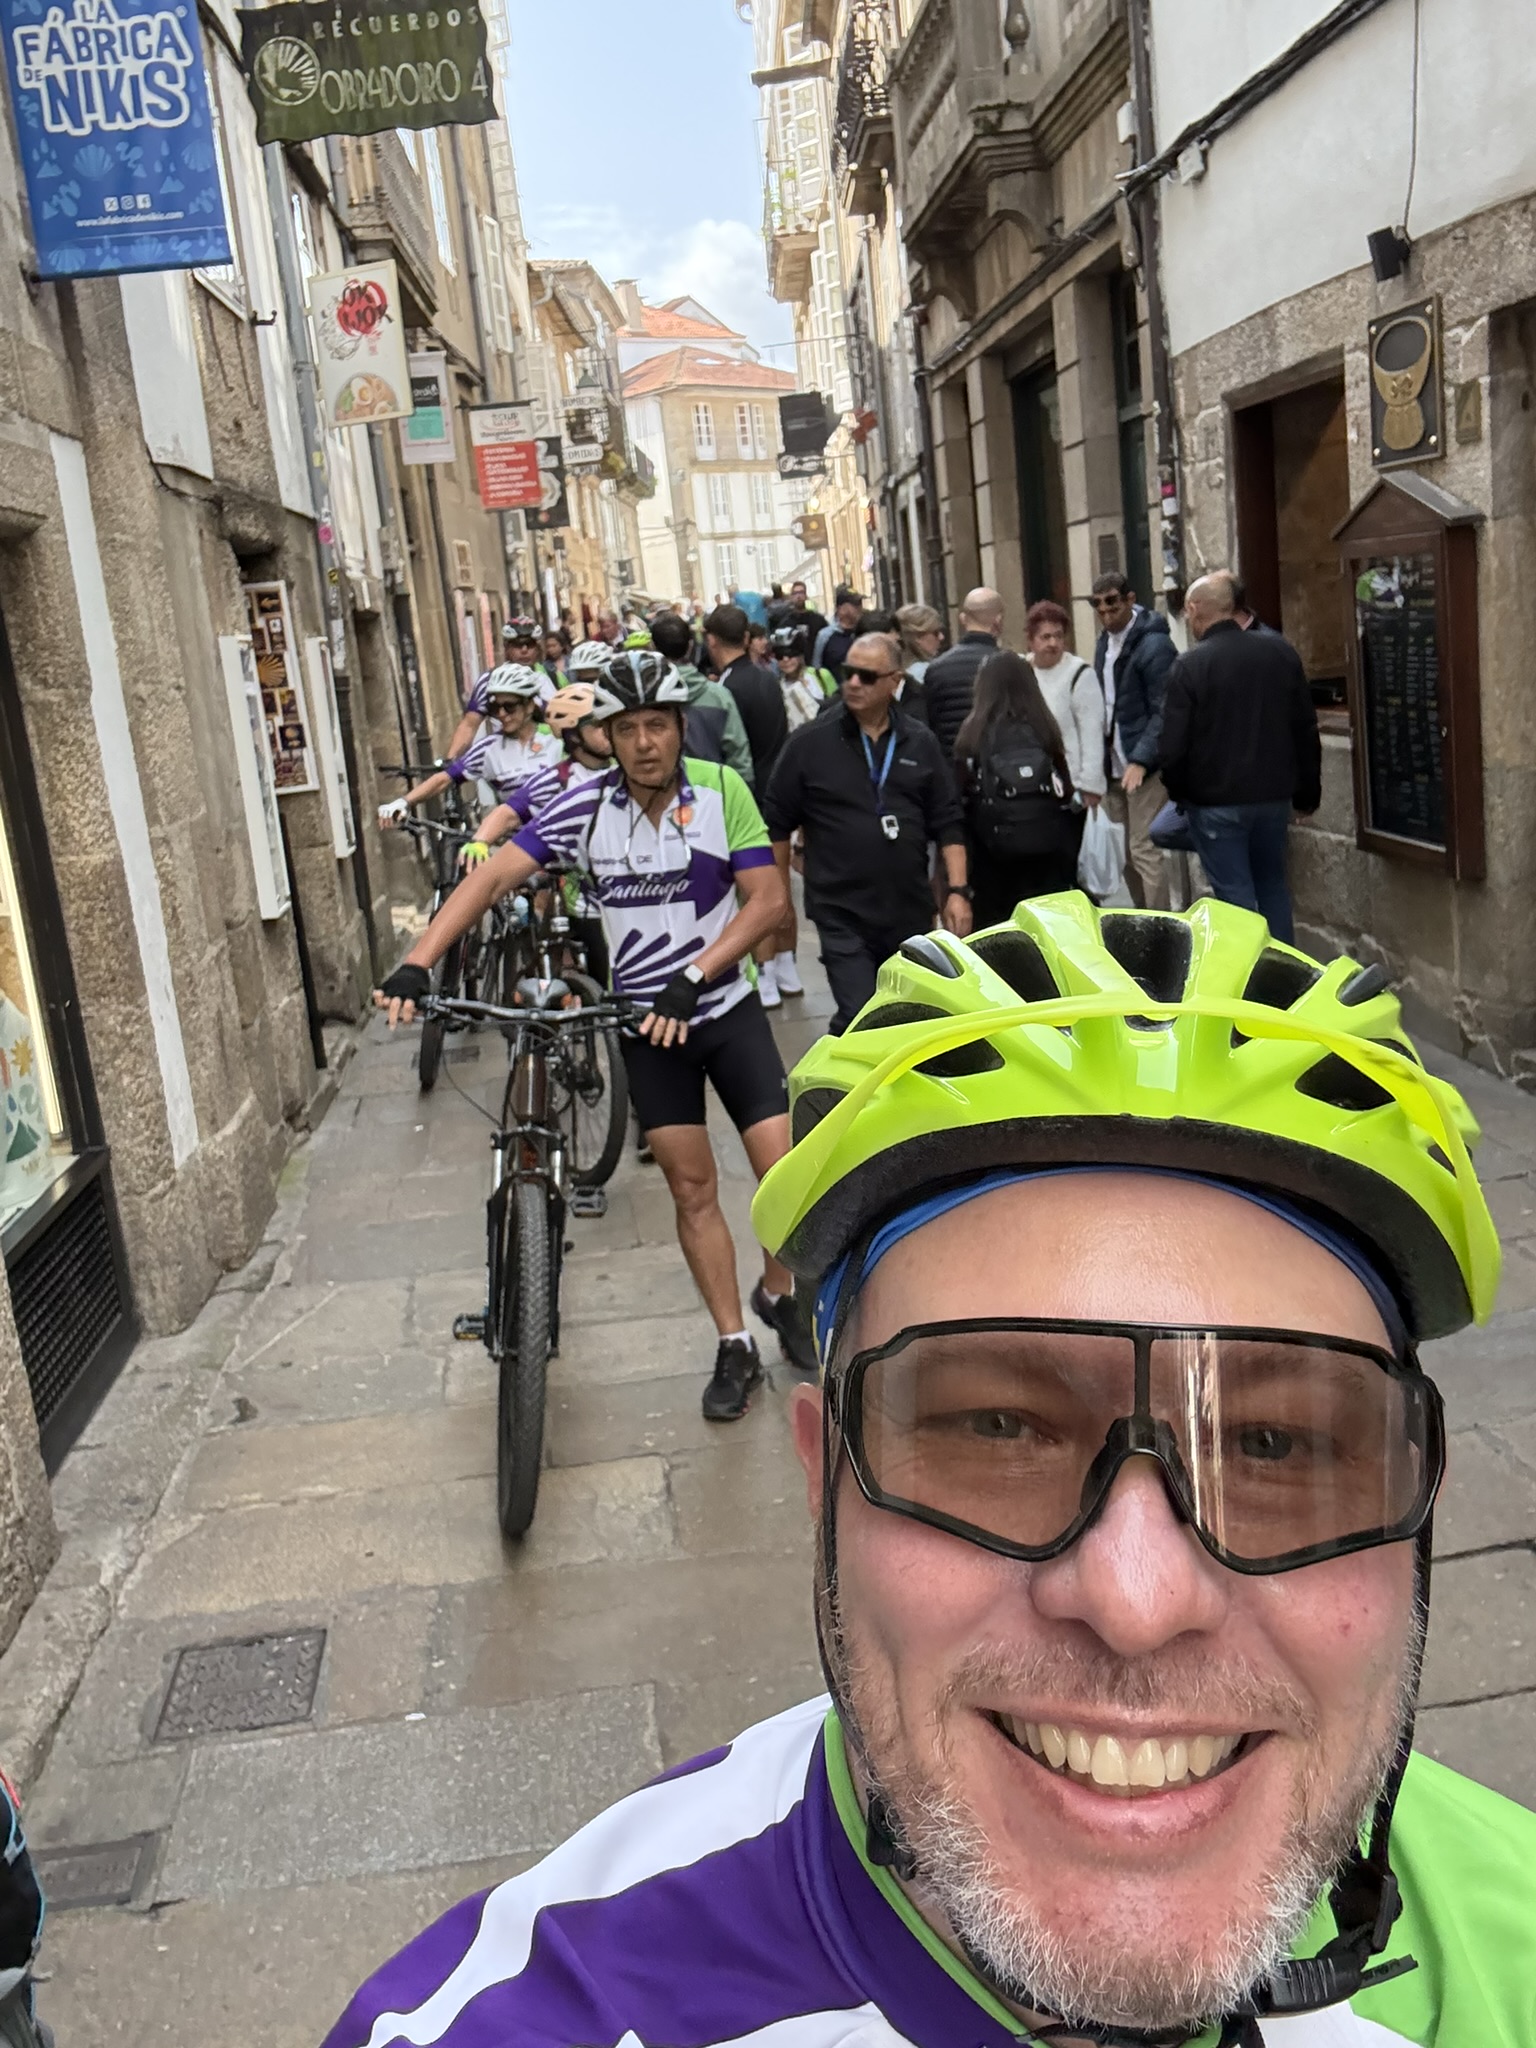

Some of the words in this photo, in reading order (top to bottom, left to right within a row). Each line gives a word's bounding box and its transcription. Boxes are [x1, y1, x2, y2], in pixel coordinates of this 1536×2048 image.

[79, 0, 114, 24] LA
[312, 6, 479, 40] RECUERDOS
[20, 12, 188, 65] FÁBRICA
[23, 67, 43, 82] DE
[45, 61, 183, 130] NIKIS
[320, 58, 461, 114] OBRADORO
